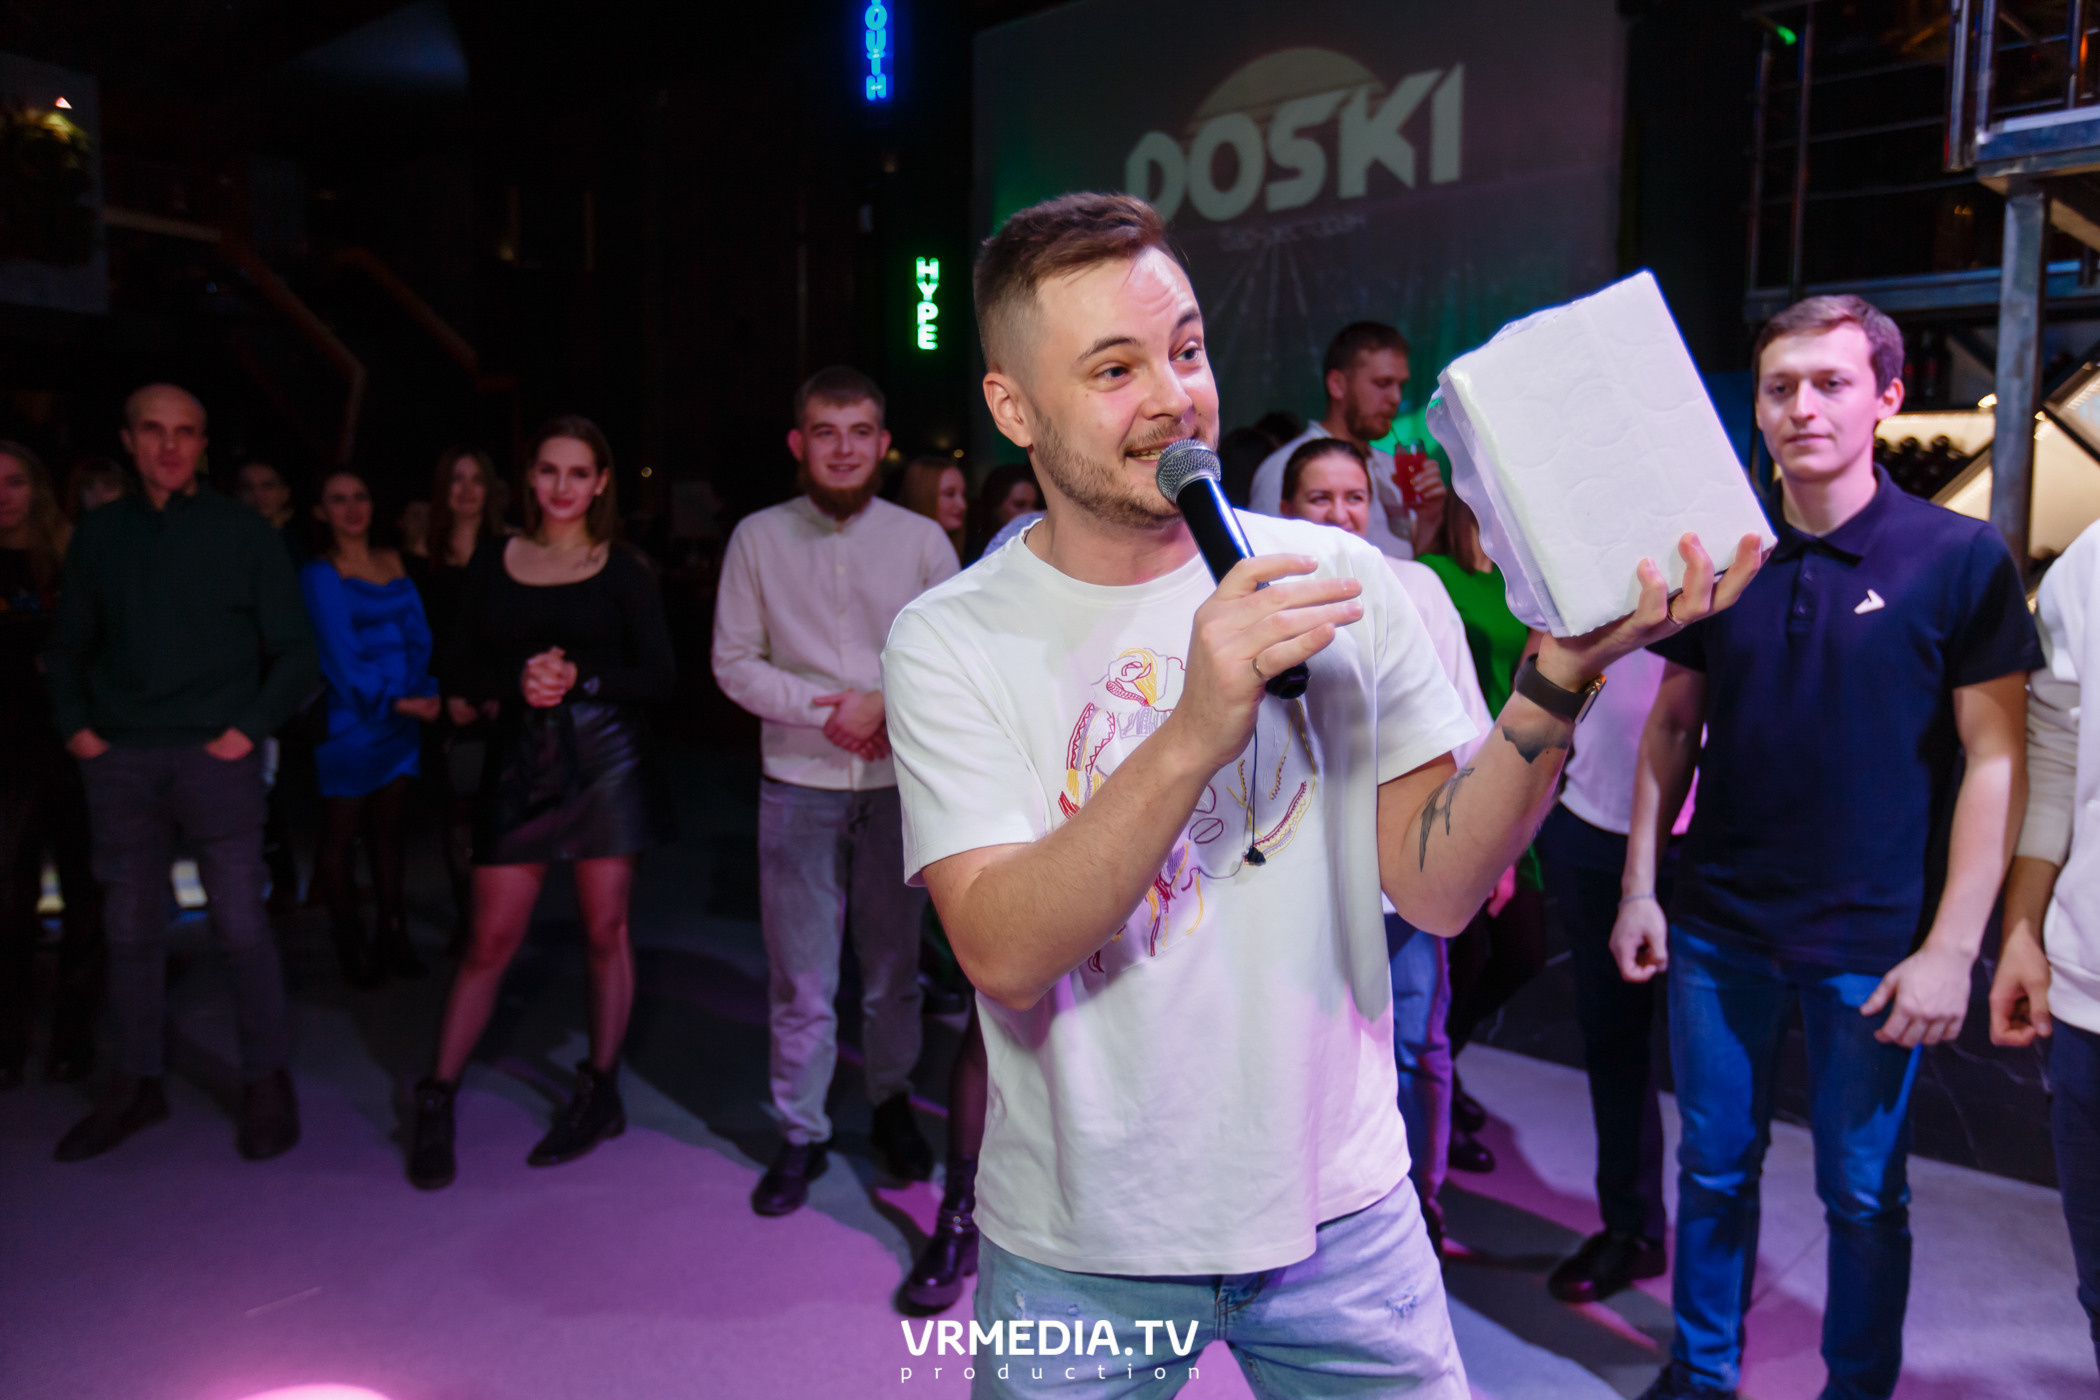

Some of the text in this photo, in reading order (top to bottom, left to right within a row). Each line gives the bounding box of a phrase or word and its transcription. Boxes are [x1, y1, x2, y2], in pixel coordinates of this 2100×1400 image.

[864, 0, 888, 101] OUTH
[1124, 63, 1465, 222] DOSKI
[915, 256, 940, 351] HYPE
